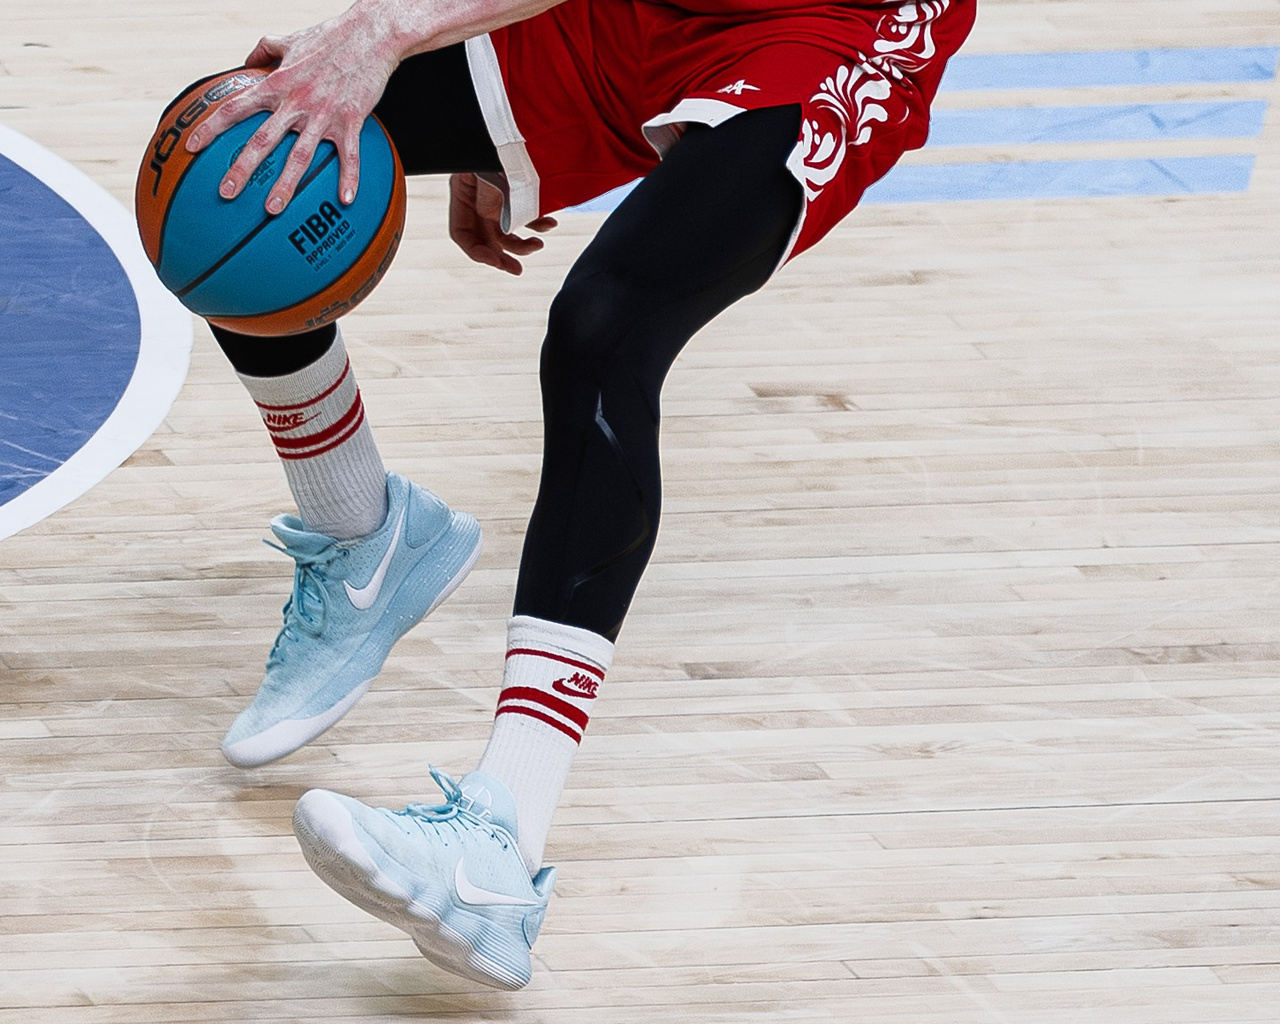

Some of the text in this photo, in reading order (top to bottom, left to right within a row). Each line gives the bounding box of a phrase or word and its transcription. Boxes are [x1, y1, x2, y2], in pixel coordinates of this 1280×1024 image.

[288, 200, 342, 255] FIBA
[306, 219, 350, 265] APPROVED
[266, 412, 305, 426] NIKE
[567, 671, 600, 694] NIKE
